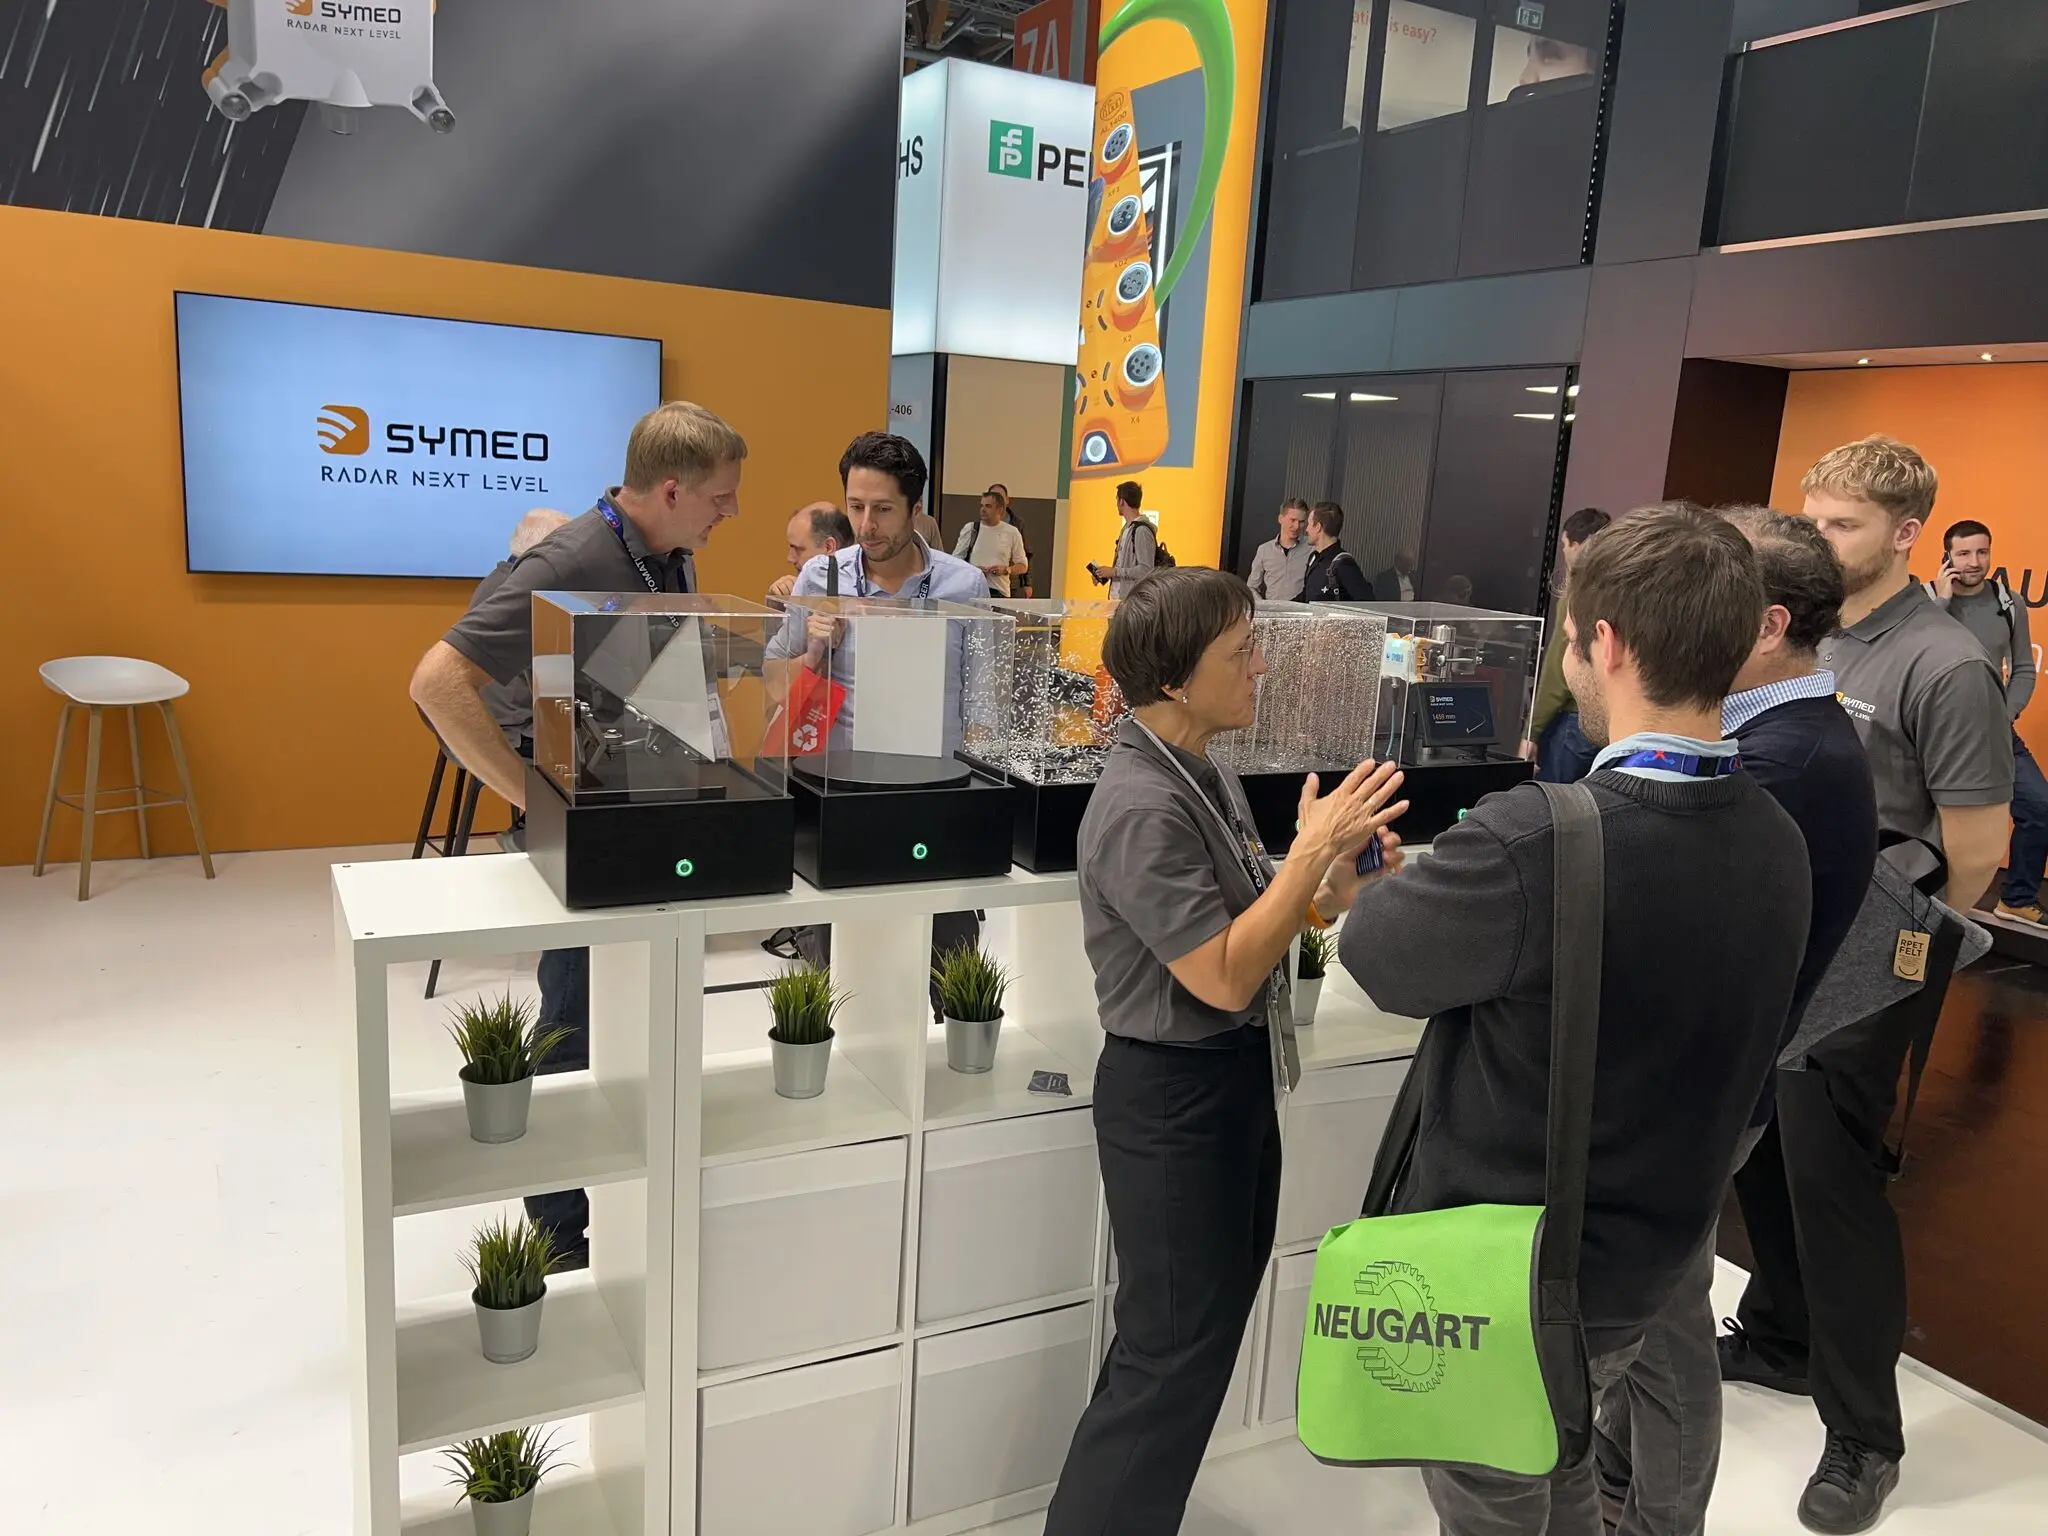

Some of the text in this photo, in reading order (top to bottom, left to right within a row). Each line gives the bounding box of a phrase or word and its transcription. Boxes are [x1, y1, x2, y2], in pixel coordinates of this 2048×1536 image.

[321, 1, 401, 23] SYMEO
[287, 18, 402, 39] RADAR NEXT LEVEL
[1402, 24, 1438, 44] easy?
[1037, 143, 1093, 189] PE
[889, 404, 912, 415] -406
[386, 423, 549, 462] SYMEO
[321, 465, 549, 493] RADAR NEXT LEVEL
[1841, 696, 1876, 713] SYMEO
[1899, 946, 1922, 957] FELT
[1900, 939, 1924, 949] RPET
[1313, 1303, 1491, 1350] NEUGART
